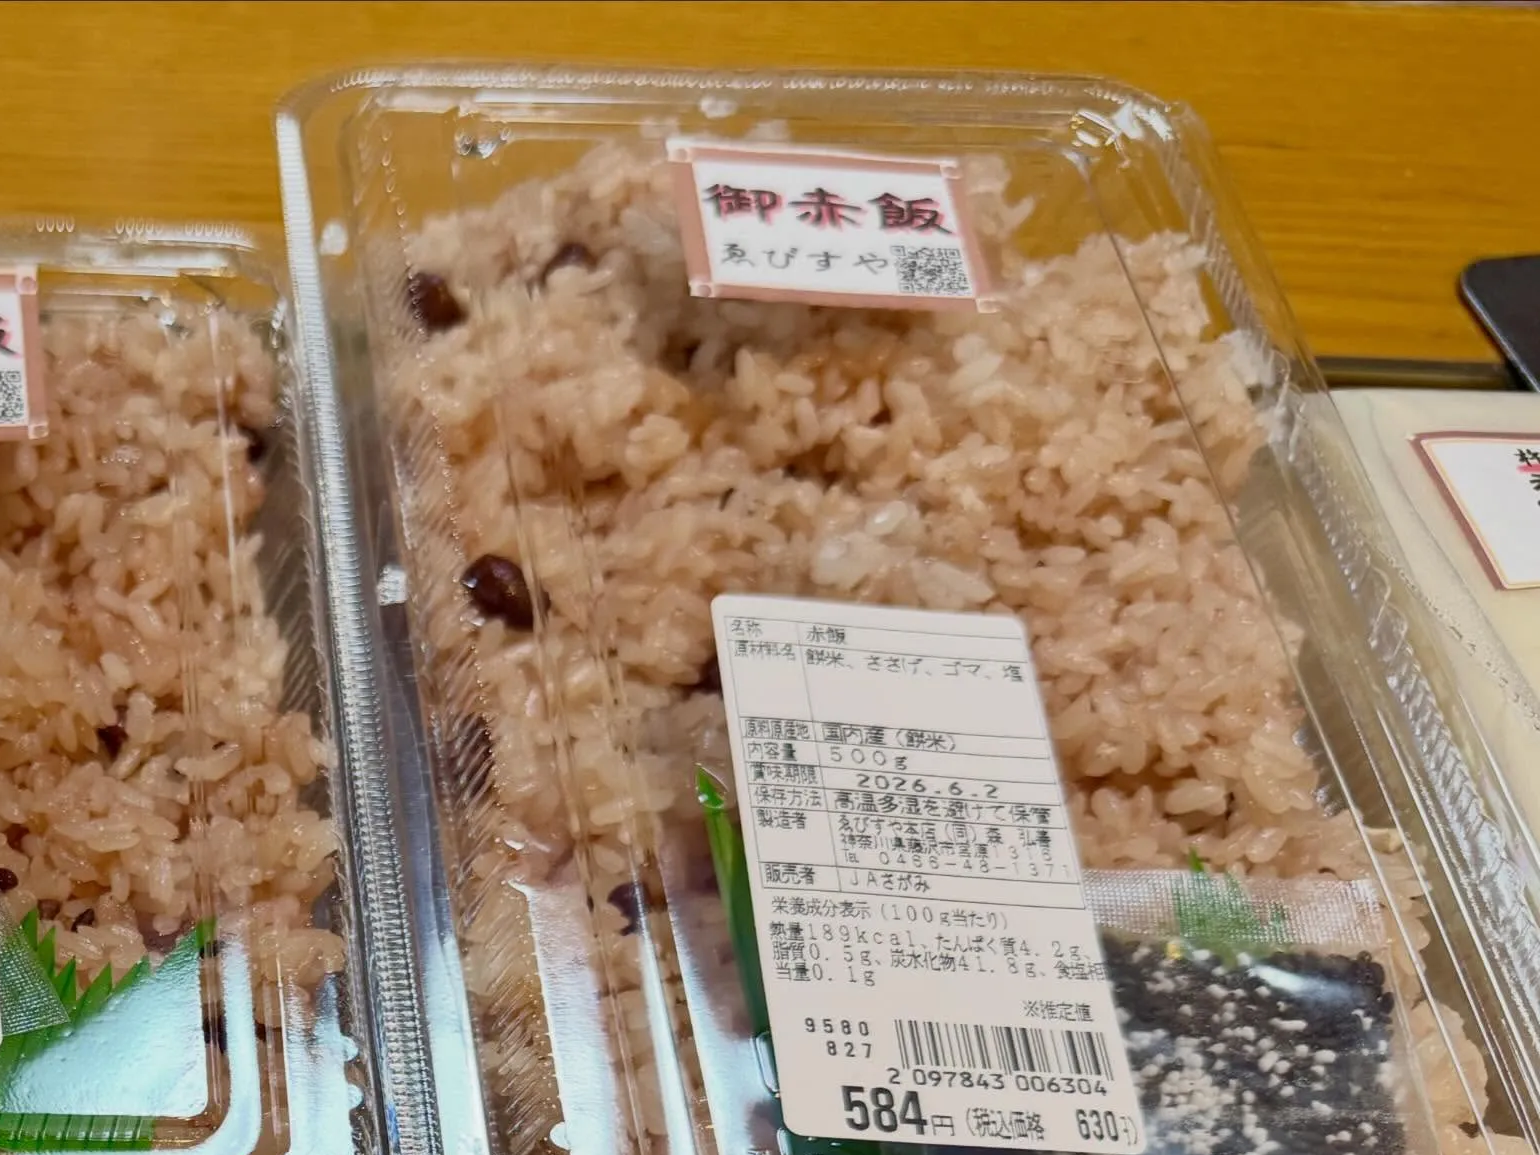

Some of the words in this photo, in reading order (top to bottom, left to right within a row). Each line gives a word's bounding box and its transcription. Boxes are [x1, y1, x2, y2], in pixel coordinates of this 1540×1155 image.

[703, 183, 958, 236] 御赤飯
[720, 243, 889, 273] ゑびすや
[804, 1017, 870, 1037] 9580
[827, 1040, 872, 1058] 827
